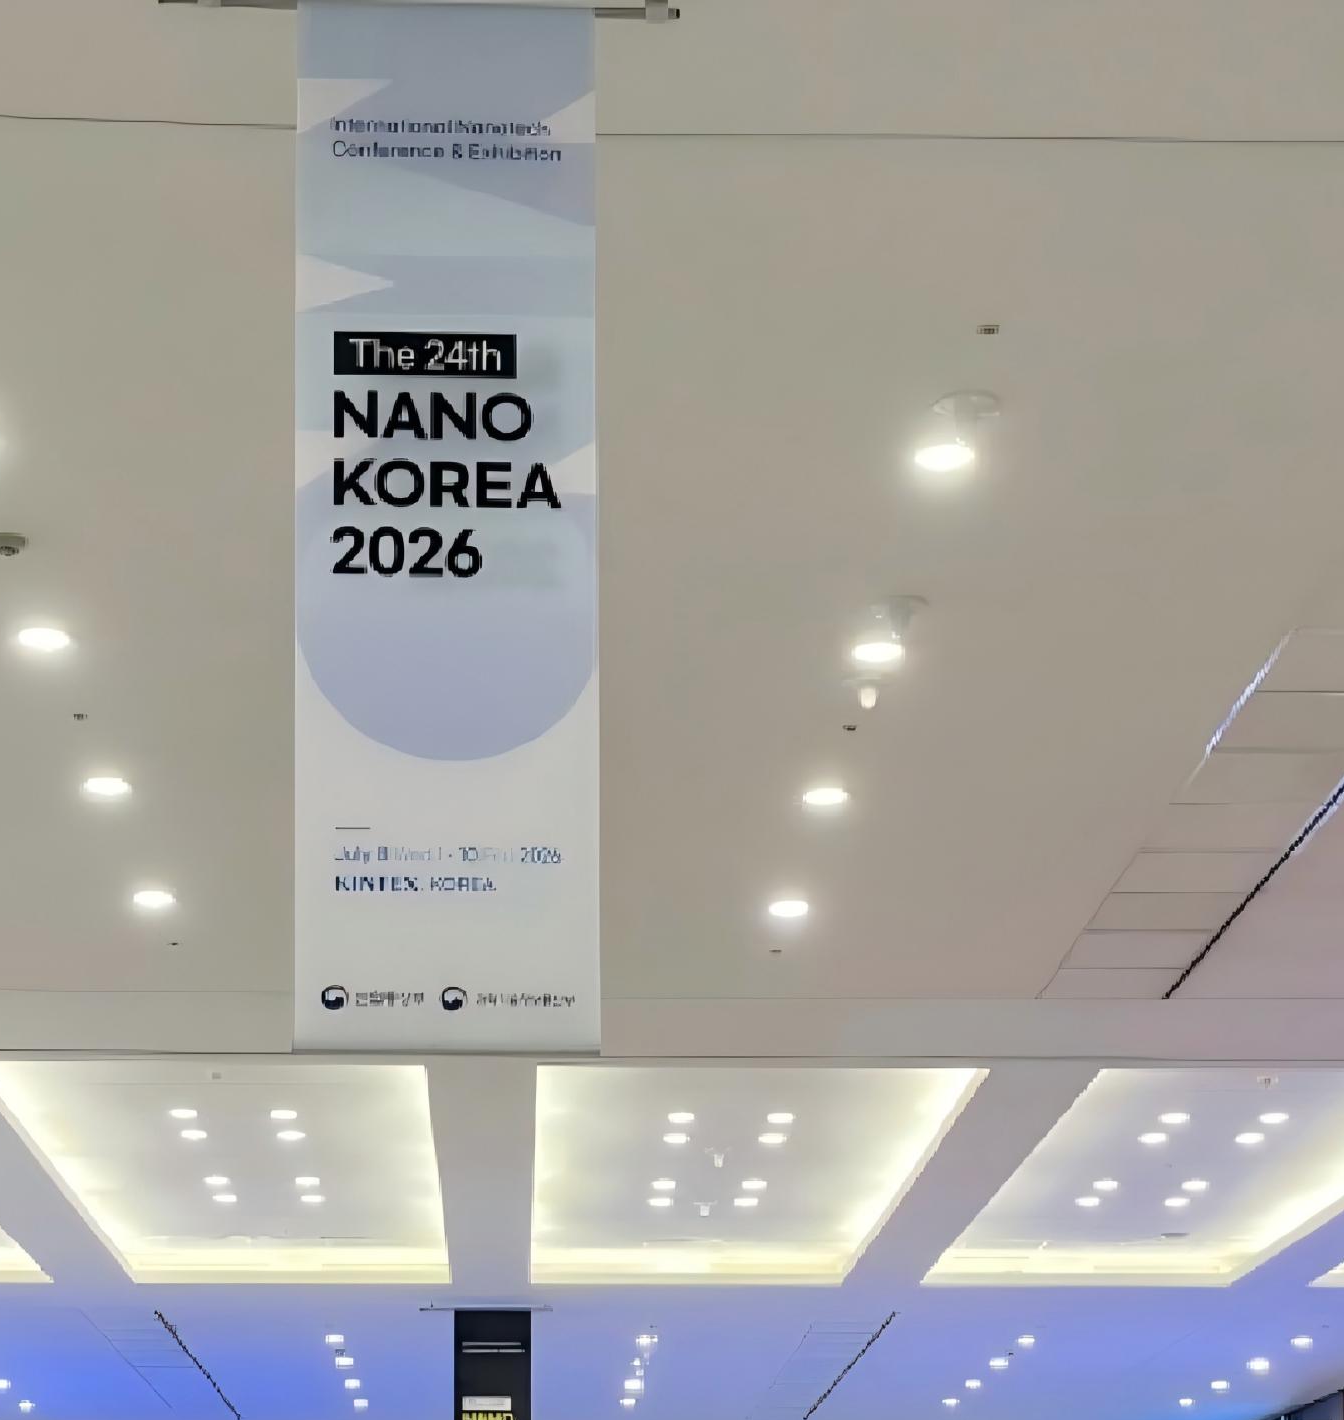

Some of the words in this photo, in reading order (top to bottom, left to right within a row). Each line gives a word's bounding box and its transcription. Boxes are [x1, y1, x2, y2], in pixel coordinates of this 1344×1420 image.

[349, 338, 416, 370] The
[424, 338, 503, 372] 24th
[333, 389, 533, 442] NANO
[333, 458, 562, 509] KOREA
[330, 525, 482, 578] 2026
